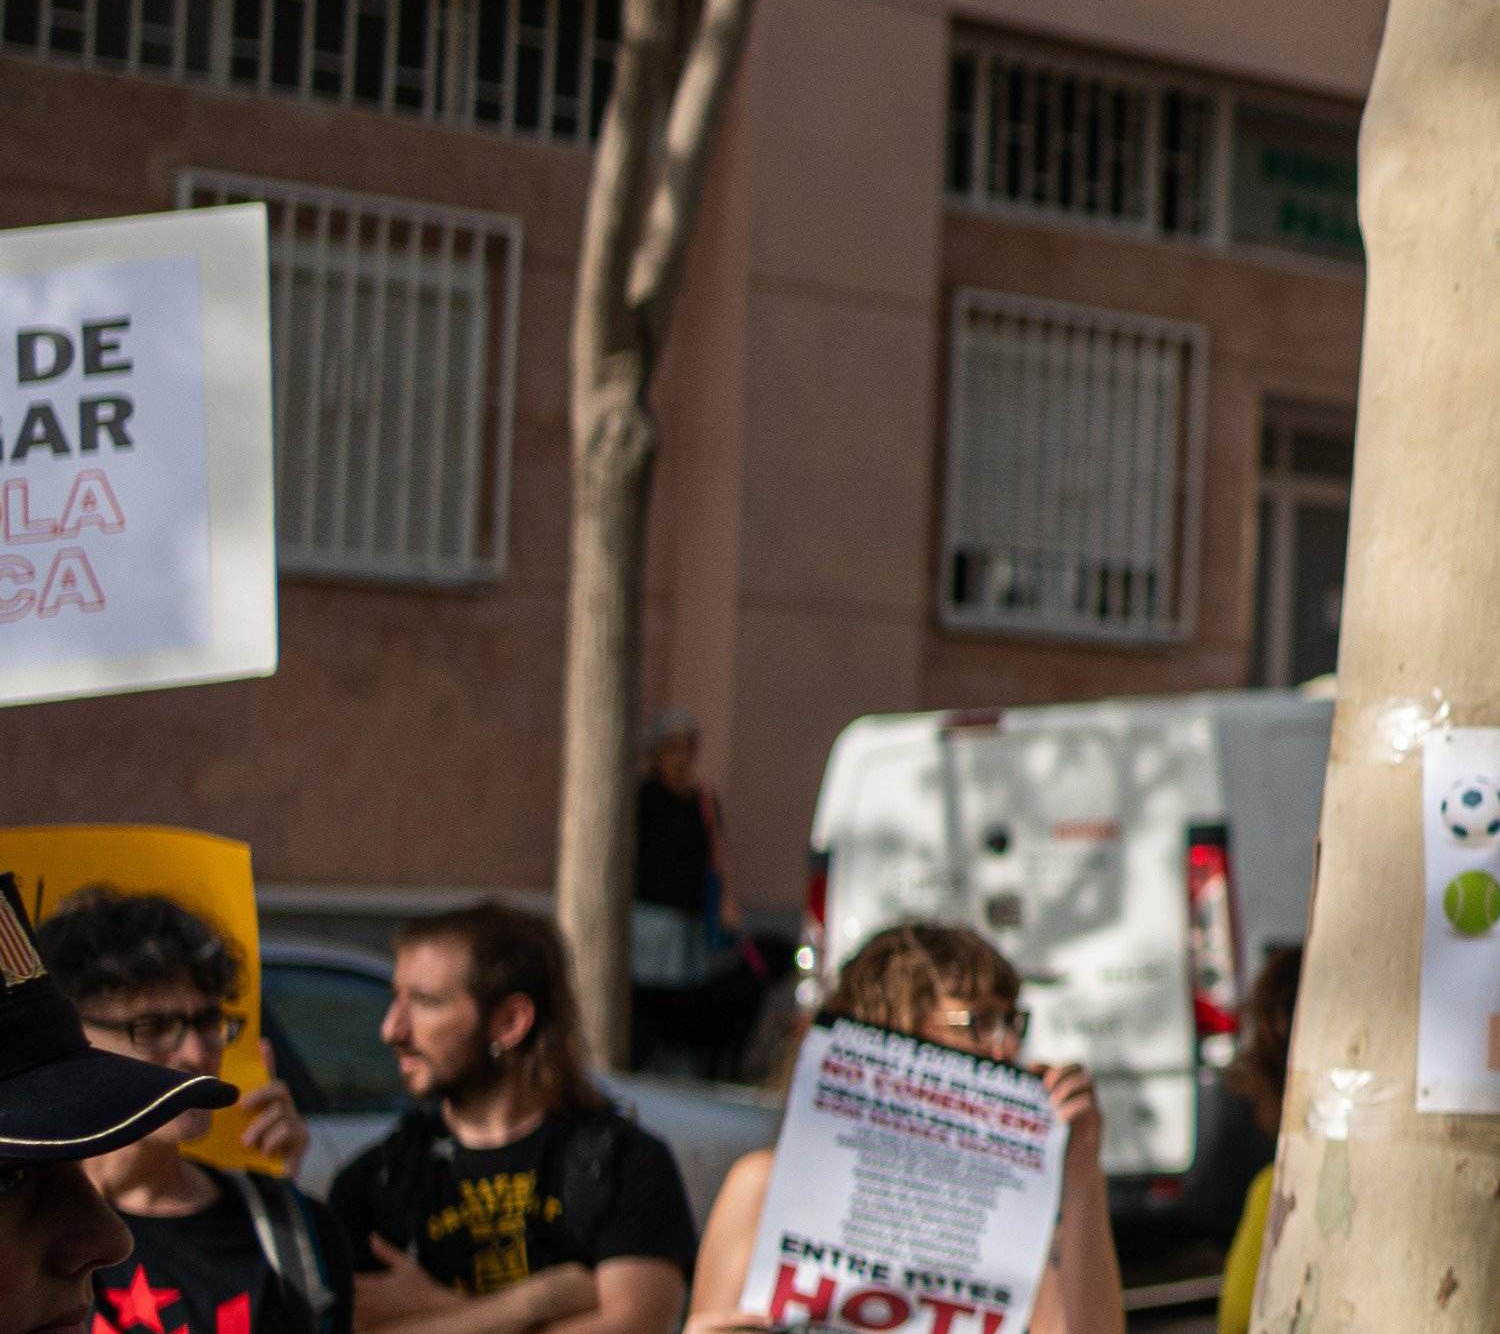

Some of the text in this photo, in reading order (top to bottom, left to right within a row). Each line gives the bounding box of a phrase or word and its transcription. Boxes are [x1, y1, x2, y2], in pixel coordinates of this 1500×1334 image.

[17, 318, 133, 385] DE
[0, 394, 134, 463] AR
[0, 469, 126, 546] LA
[781, 1233, 1012, 1306] ENTRE TOTES
